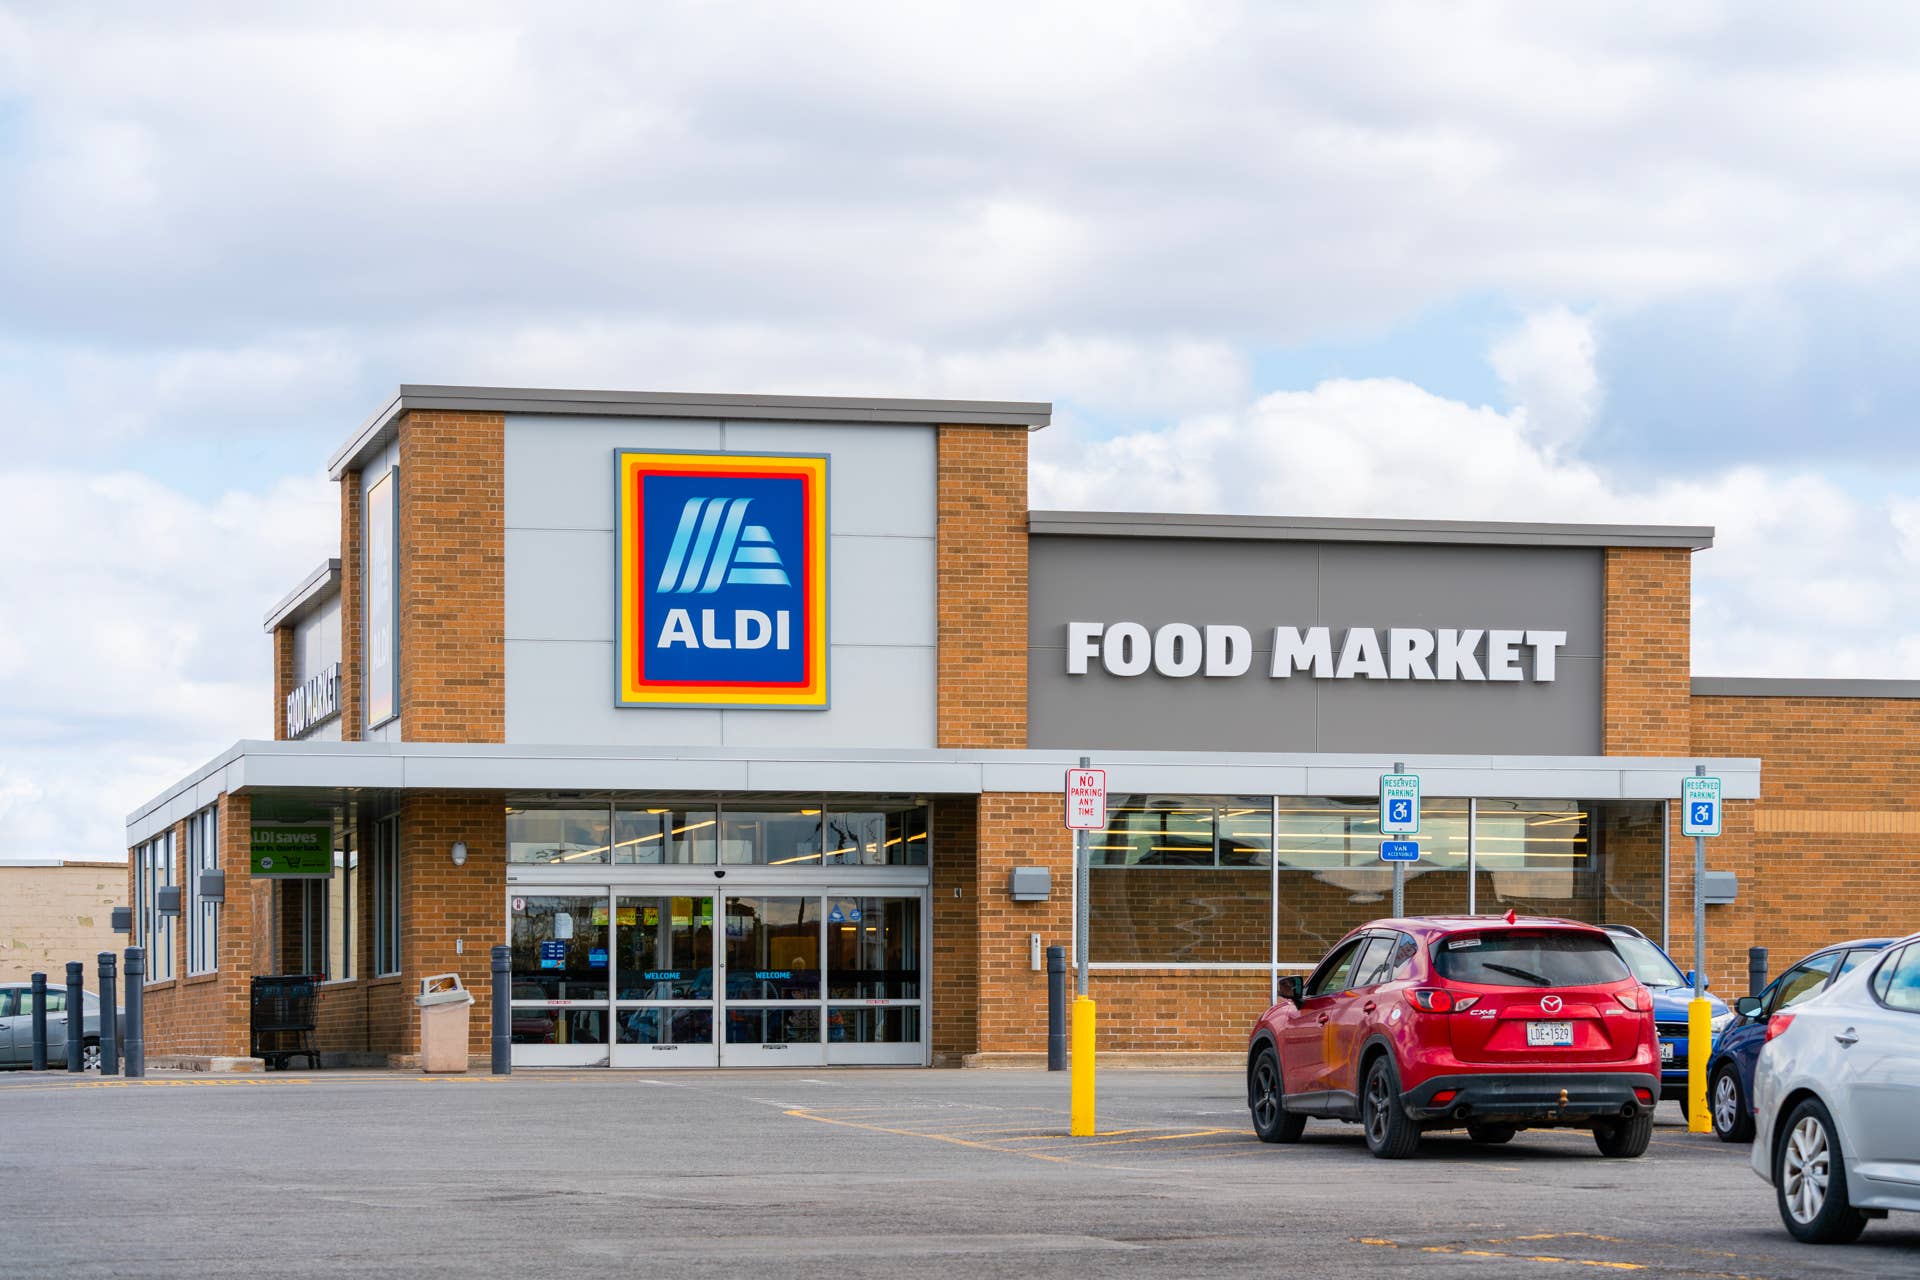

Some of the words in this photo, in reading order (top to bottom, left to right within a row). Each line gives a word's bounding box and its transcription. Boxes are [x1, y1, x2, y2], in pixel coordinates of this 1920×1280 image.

[657, 609, 789, 650] ALDI
[1066, 622, 1253, 678] FOOD
[1270, 626, 1568, 682] MARKET
[1079, 775, 1094, 787] NO
[1385, 780, 1417, 788] RESERVED
[1687, 781, 1719, 790] RESERVED
[1071, 788, 1103, 797] PARKING
[1387, 789, 1414, 798] PARKING
[1690, 791, 1716, 800] PARKING
[1079, 798, 1095, 806] ANY
[1078, 807, 1095, 816] TIME
[276, 832, 318, 844] saves
[644, 972, 681, 980] WELCOME
[755, 971, 792, 979] WELCOME
